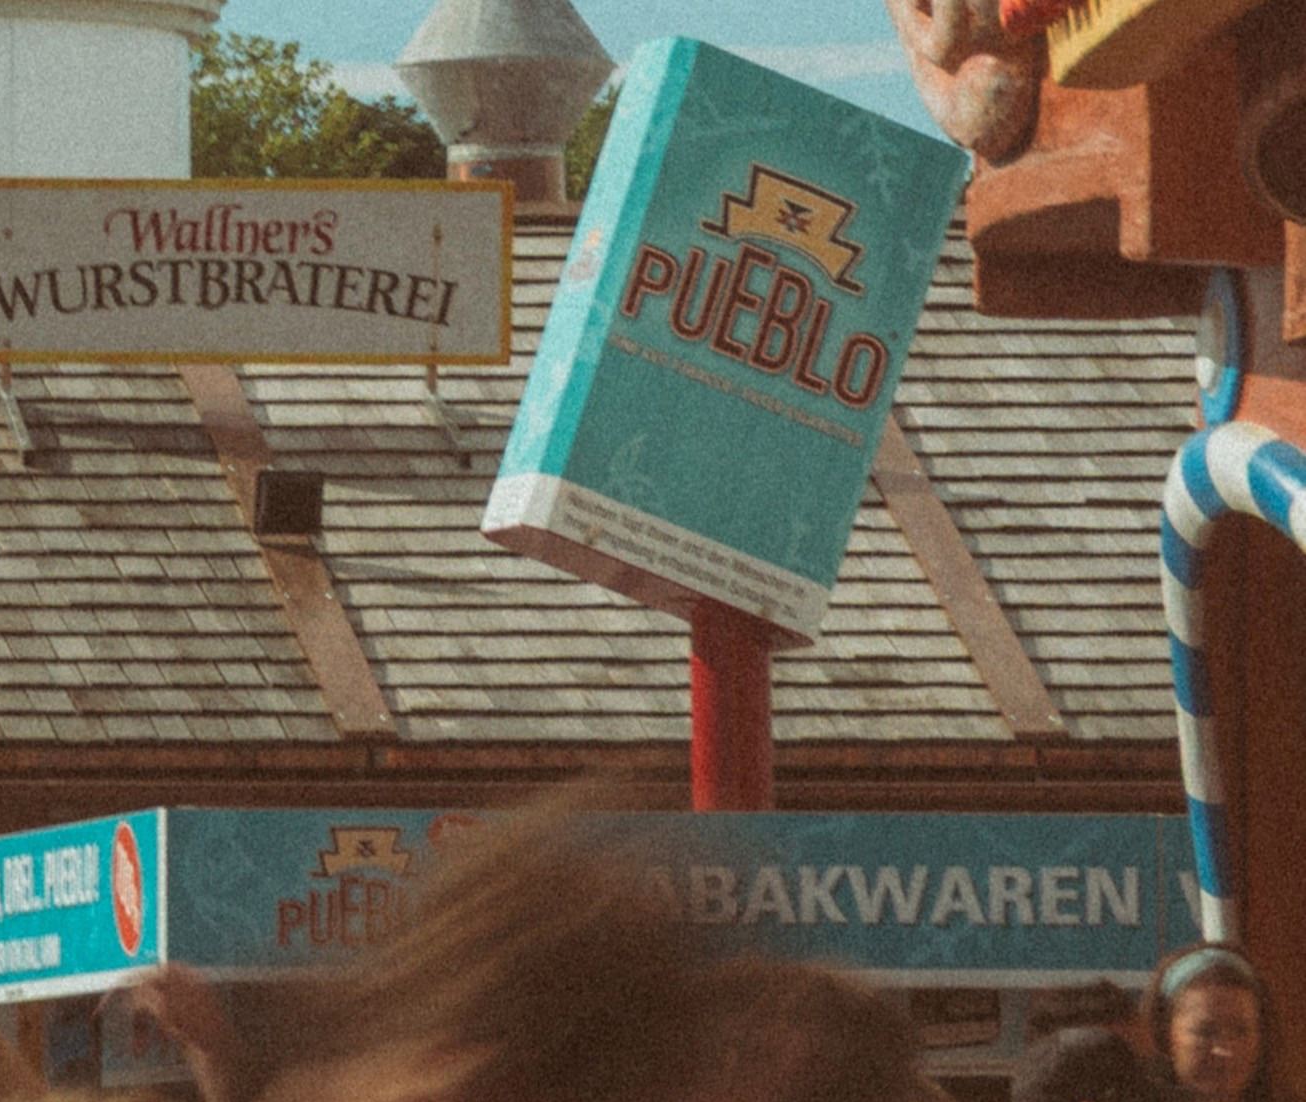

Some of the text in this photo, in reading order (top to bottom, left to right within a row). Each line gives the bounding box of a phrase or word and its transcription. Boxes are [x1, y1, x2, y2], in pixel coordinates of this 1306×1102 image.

[620, 244, 889, 410] PUEBLO
[277, 873, 404, 948] PUEB
[639, 865, 1142, 926] ABAKWAREN
